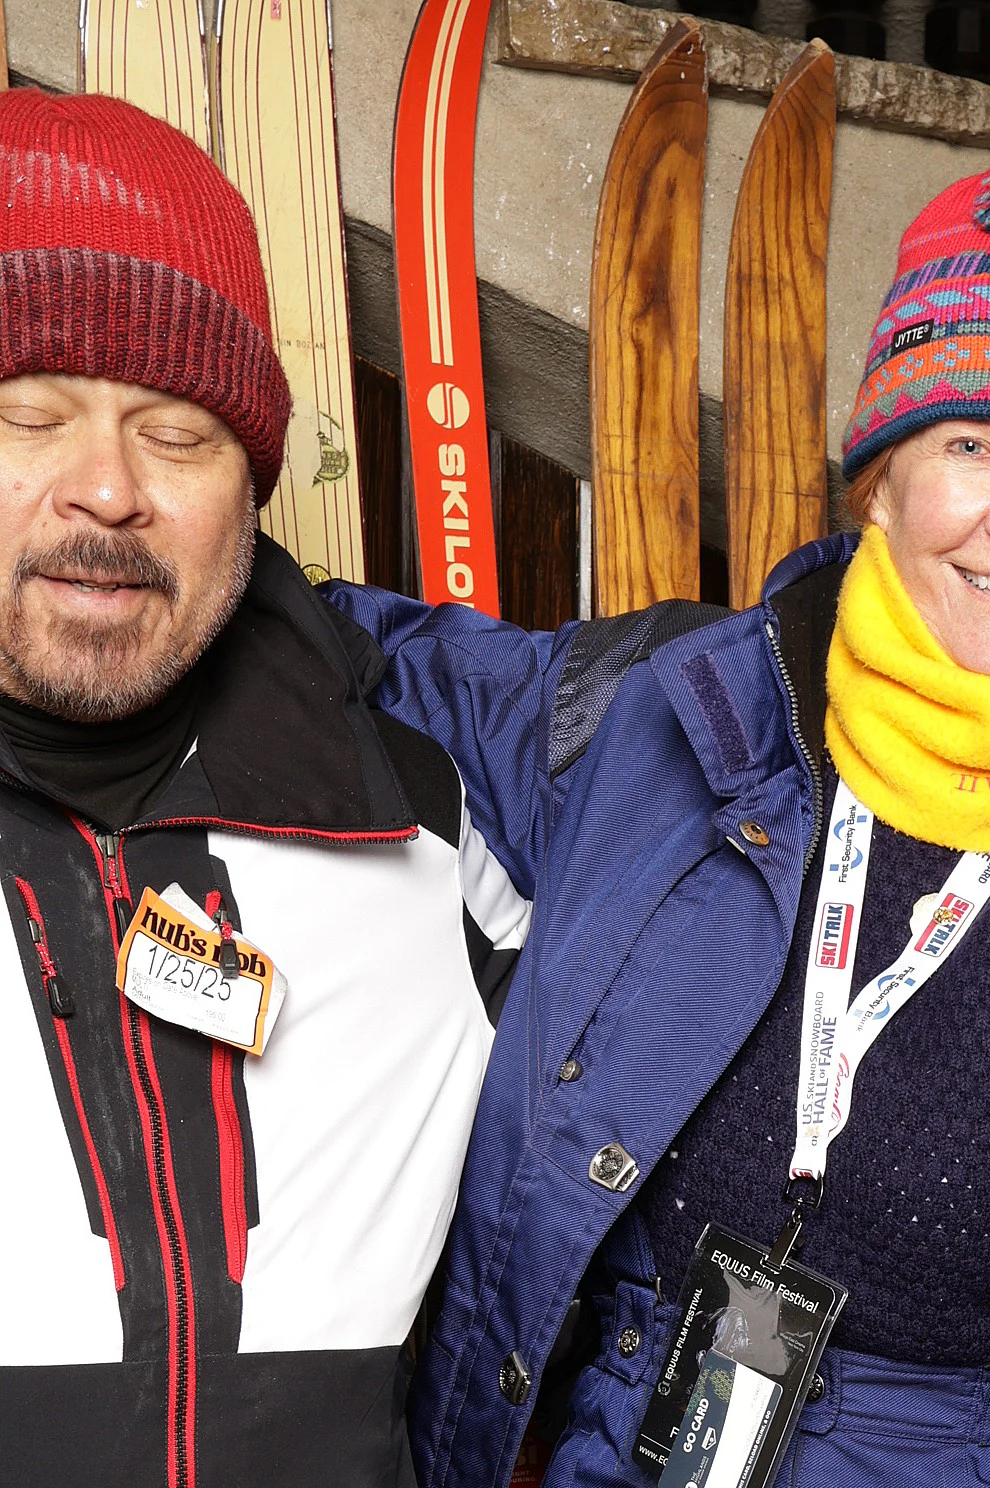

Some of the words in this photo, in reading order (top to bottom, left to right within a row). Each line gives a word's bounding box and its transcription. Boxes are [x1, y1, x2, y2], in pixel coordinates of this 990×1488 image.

[437, 443, 475, 609] SKILO
[845, 803, 857, 825] Bank
[840, 826, 855, 862] Security
[838, 862, 849, 883] First
[141, 906, 207, 956] nub's
[824, 904, 842, 940] TALK
[923, 919, 955, 955] TALK
[149, 946, 231, 1001] 1/25/25
[820, 941, 836, 965] SKI
[895, 966, 914, 982] First
[868, 981, 897, 1009] Security
[802, 1101, 812, 1123] U.S.
[809, 991, 823, 1061] SNOWBOARD
[816, 1015, 837, 1066] FAME
[818, 1068, 826, 1078] OF
[811, 1076, 829, 1123] HALL
[709, 1249, 751, 1279] EQUUS
[749, 1269, 776, 1291] Film
[775, 1282, 819, 1314] Festival
[664, 1348, 681, 1380] EQUUS
[675, 1327, 689, 1348] FILM
[683, 1287, 703, 1326] FESTIVAL
[681, 1430, 697, 1453] GO
[689, 1397, 710, 1432] CARD
